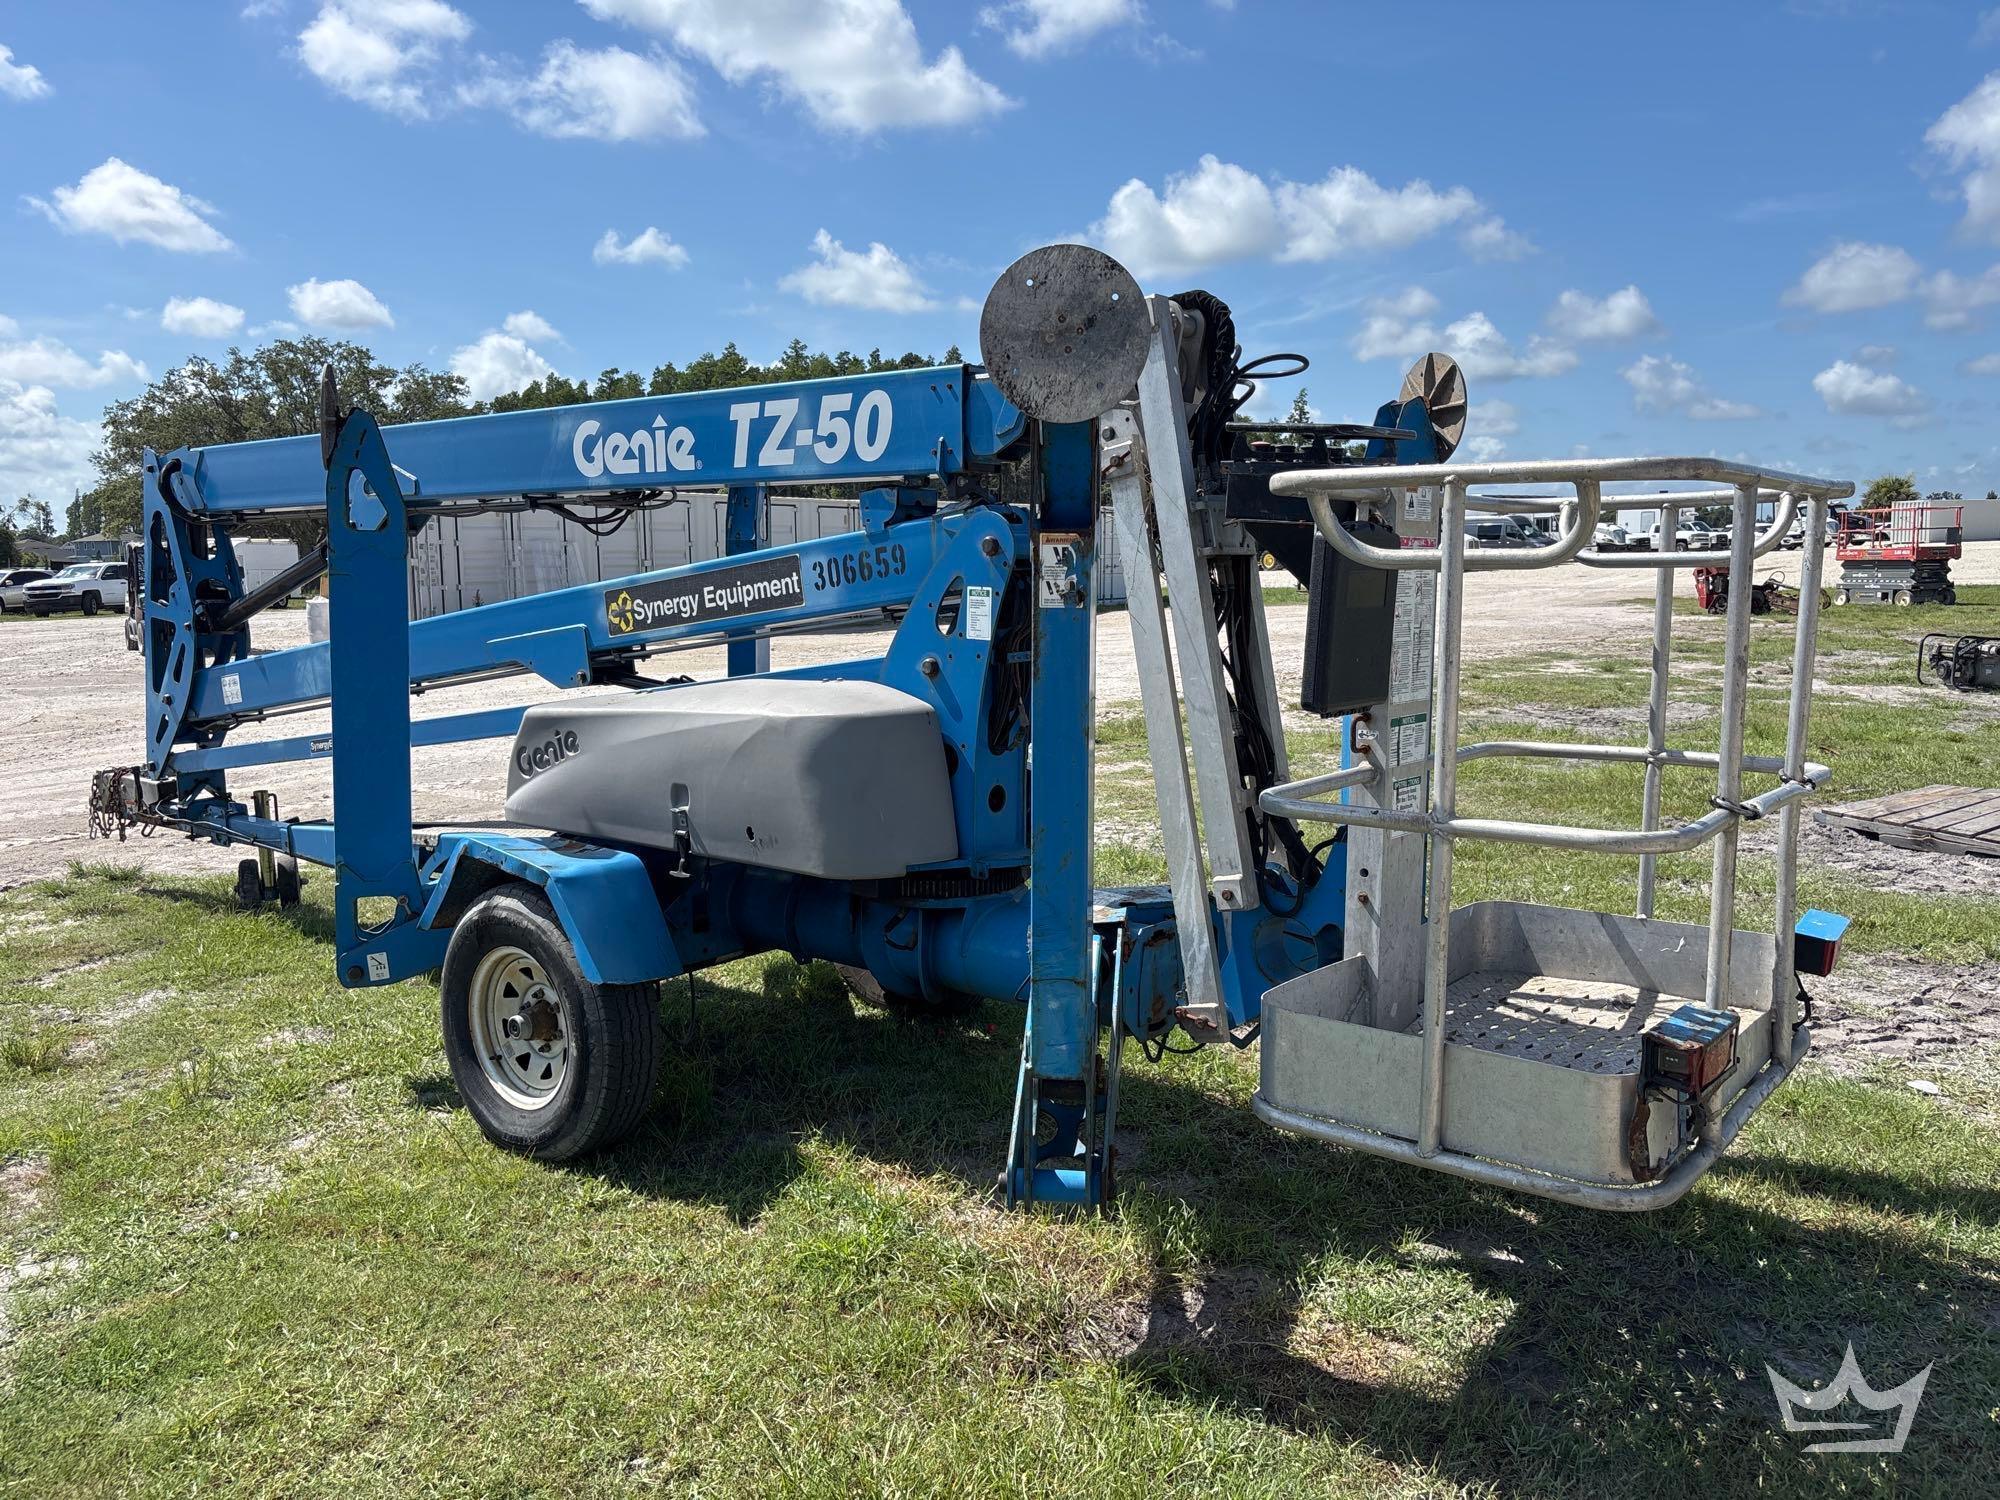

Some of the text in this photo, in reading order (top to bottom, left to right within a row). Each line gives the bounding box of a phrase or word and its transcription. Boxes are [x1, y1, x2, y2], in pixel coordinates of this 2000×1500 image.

[573, 389, 893, 478] Genie TZ-50
[812, 543, 907, 592] 306659
[633, 571, 801, 624] Synergy Equipment
[516, 729, 580, 779] Genie
